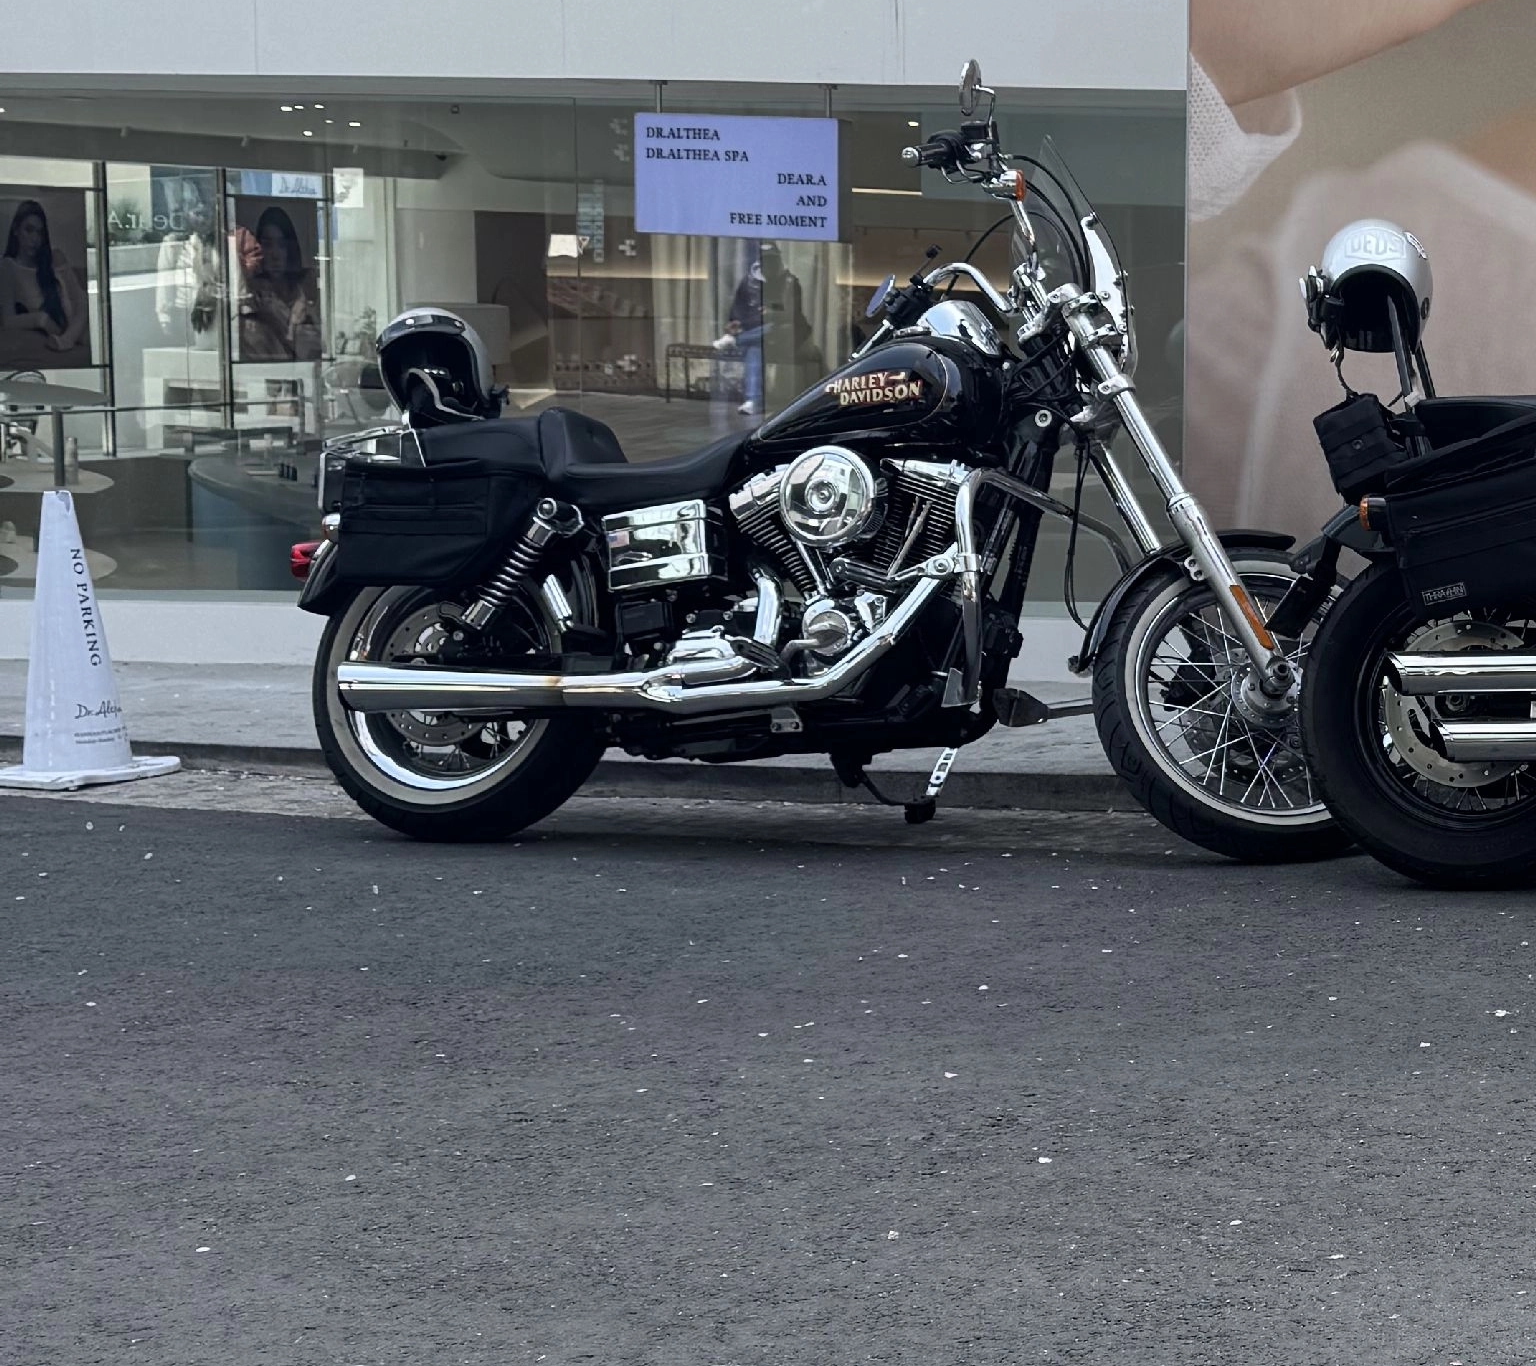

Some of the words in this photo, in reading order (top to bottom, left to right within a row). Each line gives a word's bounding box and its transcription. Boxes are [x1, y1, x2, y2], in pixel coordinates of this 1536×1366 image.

[646, 126, 720, 141] DR.ALTHEA
[646, 147, 720, 162] DR.ALTHEA
[724, 150, 749, 162] SPA
[777, 173, 827, 186] DEAR.A
[796, 195, 828, 207] AND
[730, 212, 762, 226] FREE
[767, 214, 828, 228] MOMENT
[840, 380, 922, 406] DAVIDSON
[70, 548, 84, 575] NO
[77, 583, 102, 667] PARKING
